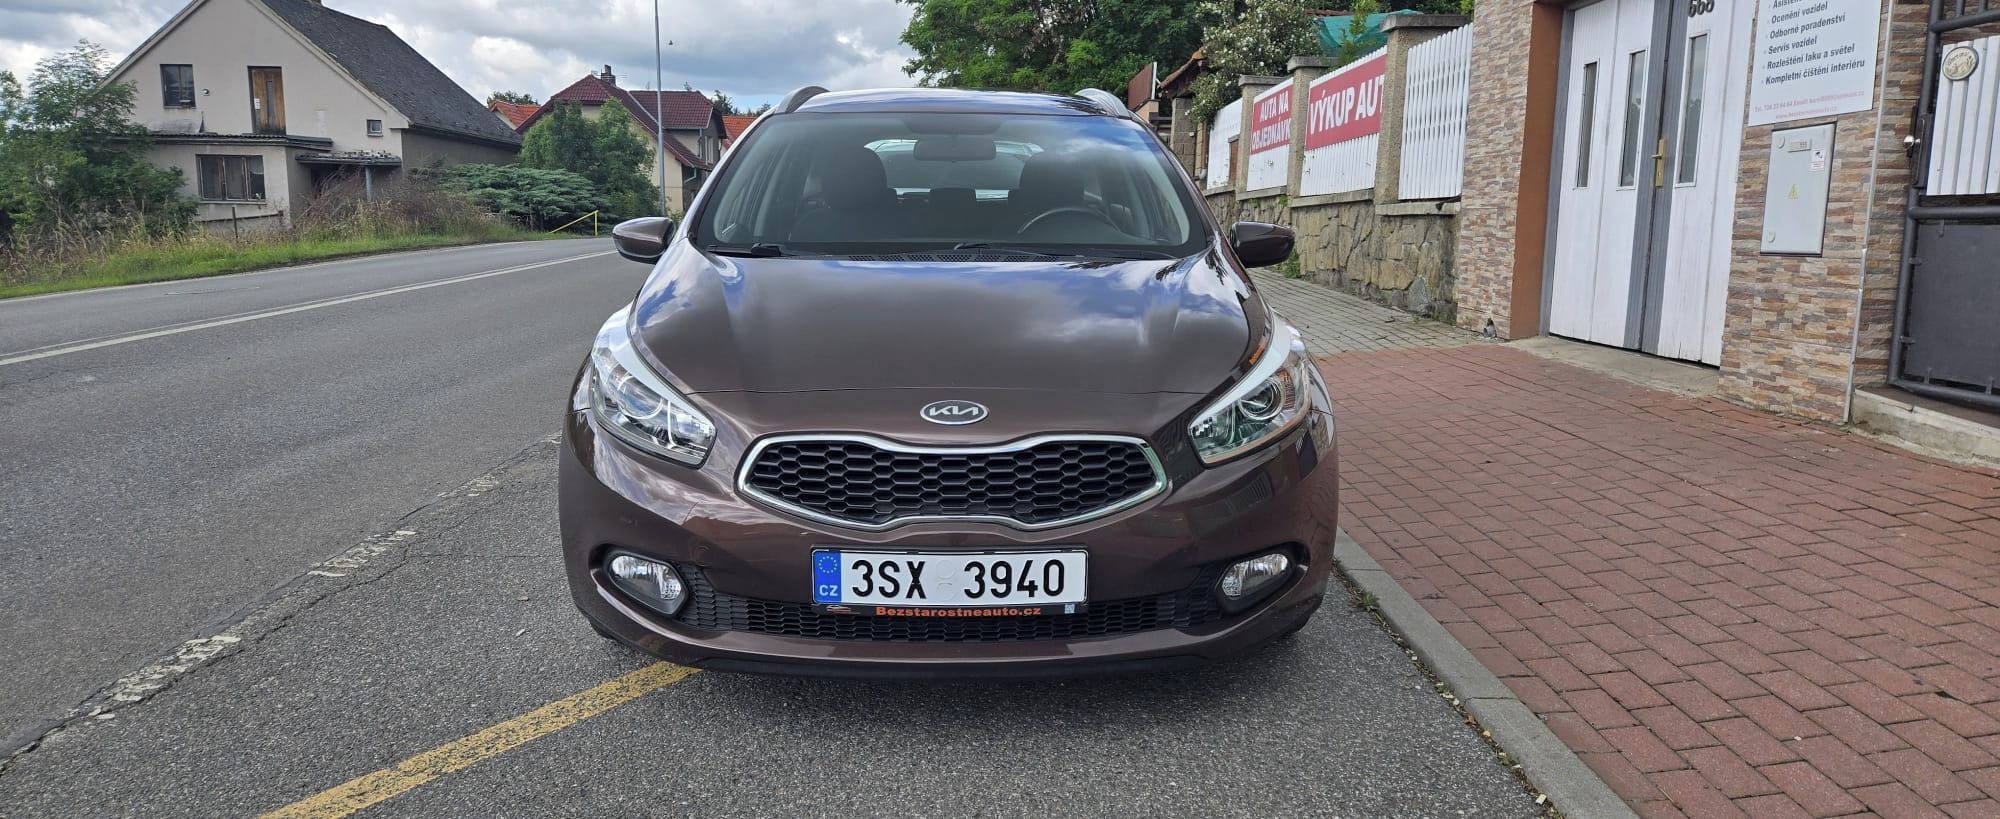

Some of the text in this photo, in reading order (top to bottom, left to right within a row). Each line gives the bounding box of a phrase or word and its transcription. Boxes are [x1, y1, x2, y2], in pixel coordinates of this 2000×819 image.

[1770, 12, 1846, 39] Odborné poradenství
[1771, 1, 1828, 24] Ocenění vozidel
[1766, 52, 1804, 70] Rozleštění
[1805, 50, 1822, 61] laku
[1830, 43, 1855, 57] světel
[1768, 35, 1818, 55] Servis vozidel
[1765, 59, 1865, 85] Kompletní čištění interiéru
[1260, 91, 1289, 123] AUTA NA
[1310, 86, 1355, 135] VÝKUP
[929, 405, 979, 416] KIA
[819, 584, 838, 597] CZ
[851, 559, 1065, 599] 3SX 3940
[876, 606, 1041, 617] Bezstarostneauto.cz
